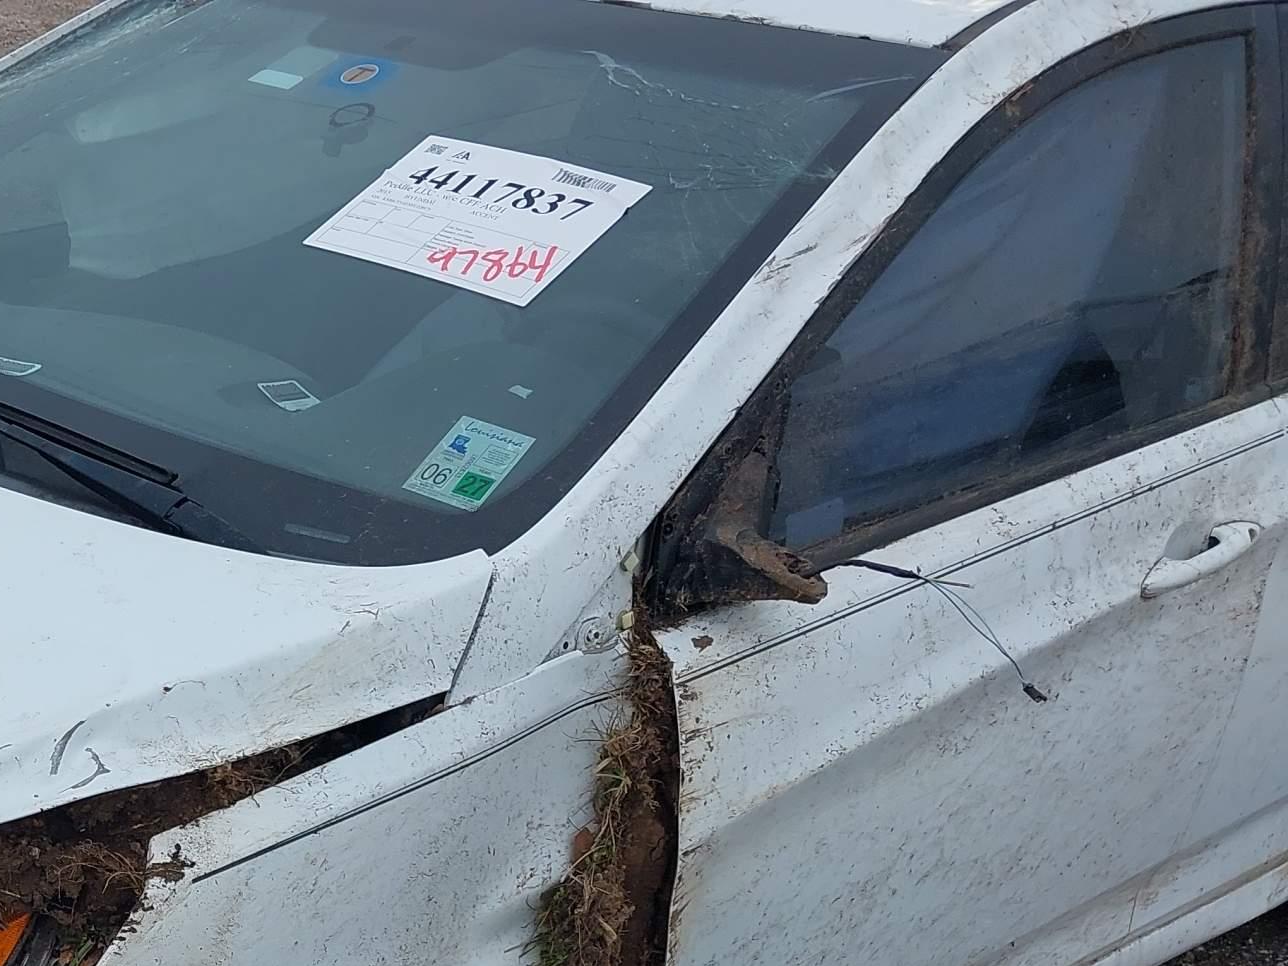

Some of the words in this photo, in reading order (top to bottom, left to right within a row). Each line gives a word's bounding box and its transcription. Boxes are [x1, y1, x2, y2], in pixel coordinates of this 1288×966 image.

[408, 165, 595, 222] 44117837
[420, 463, 453, 486] 06
[459, 475, 490, 497] 27
